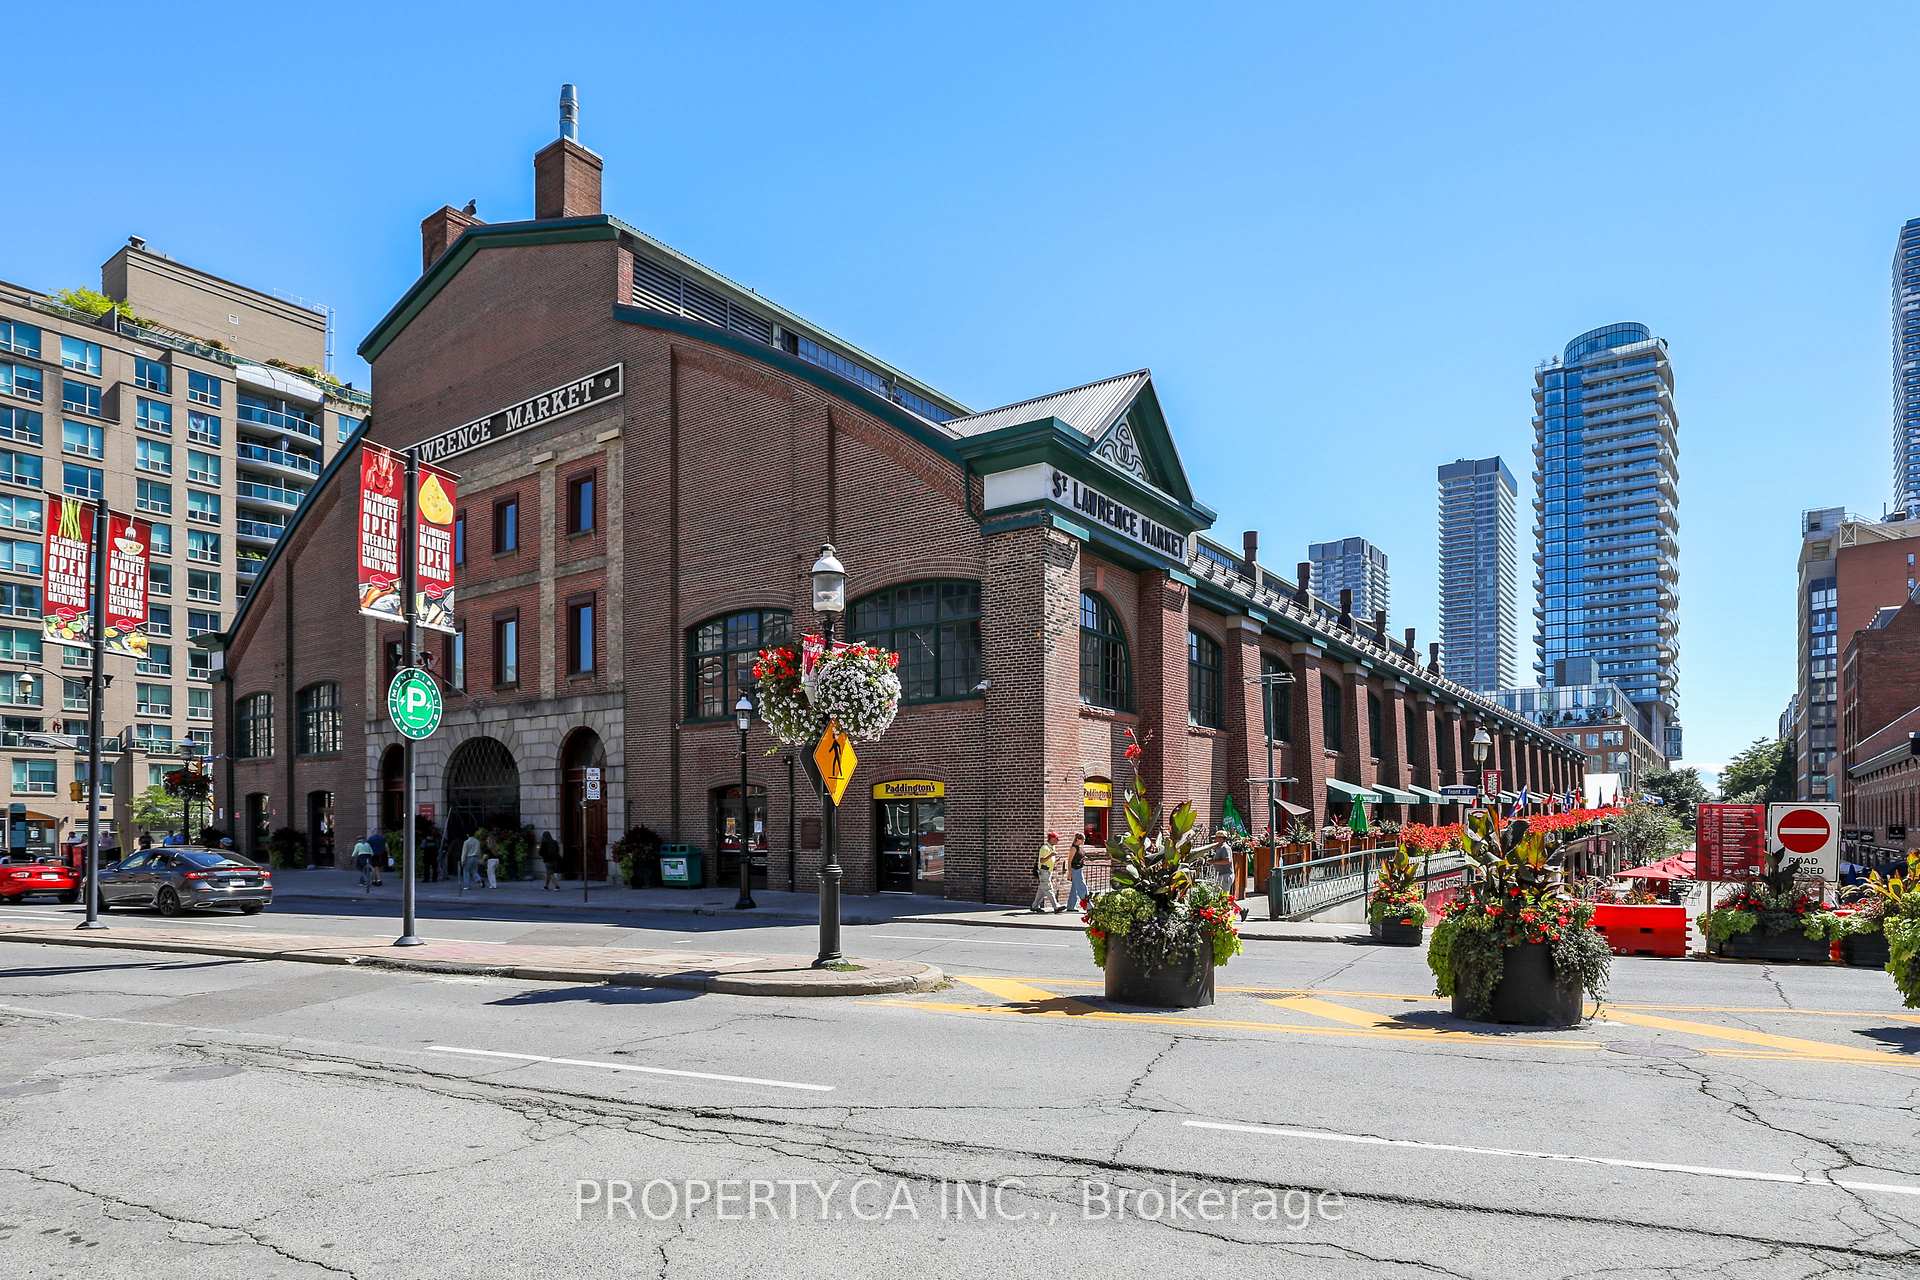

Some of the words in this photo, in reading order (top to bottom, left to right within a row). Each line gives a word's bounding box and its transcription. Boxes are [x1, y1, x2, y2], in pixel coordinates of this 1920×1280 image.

[506, 378, 594, 432] MARKET
[372, 492, 398, 508] LAWRENCE
[364, 499, 398, 522] MARKET
[1074, 482, 1138, 537] LAWRENCE
[1142, 519, 1184, 558] MARKET
[363, 513, 397, 540] OPEN
[427, 526, 450, 541] LAWRENCE
[59, 537, 87, 551] LAWRENCE
[363, 532, 397, 551] WEEKDAY
[420, 533, 450, 553] MARKET
[50, 543, 87, 562] MARKET
[363, 544, 397, 563] EVENINGS
[419, 547, 450, 571] OPEN
[49, 555, 86, 578] OPEN
[110, 558, 145, 575] MARKET
[363, 555, 380, 570] UNTIL
[381, 561, 397, 574] 7PM
[419, 564, 450, 582] SUNDAYS
[49, 571, 86, 587] WEEKDAY
[110, 570, 144, 590] OPEN
[48, 582, 86, 598] EVENINGS
[110, 584, 143, 600] WEEKDAY
[48, 592, 68, 605] UNTIL
[68, 595, 86, 608] 7PM
[109, 594, 143, 611] EVENINGS
[109, 605, 126, 616] UNTIL
[128, 608, 143, 620] 7PM
[392, 672, 438, 704] MUNICIPAL
[407, 687, 426, 713] P
[392, 706, 438, 736] PARKING
[886, 782, 936, 795] Paddington's
[1788, 856, 1818, 864] ROAD
